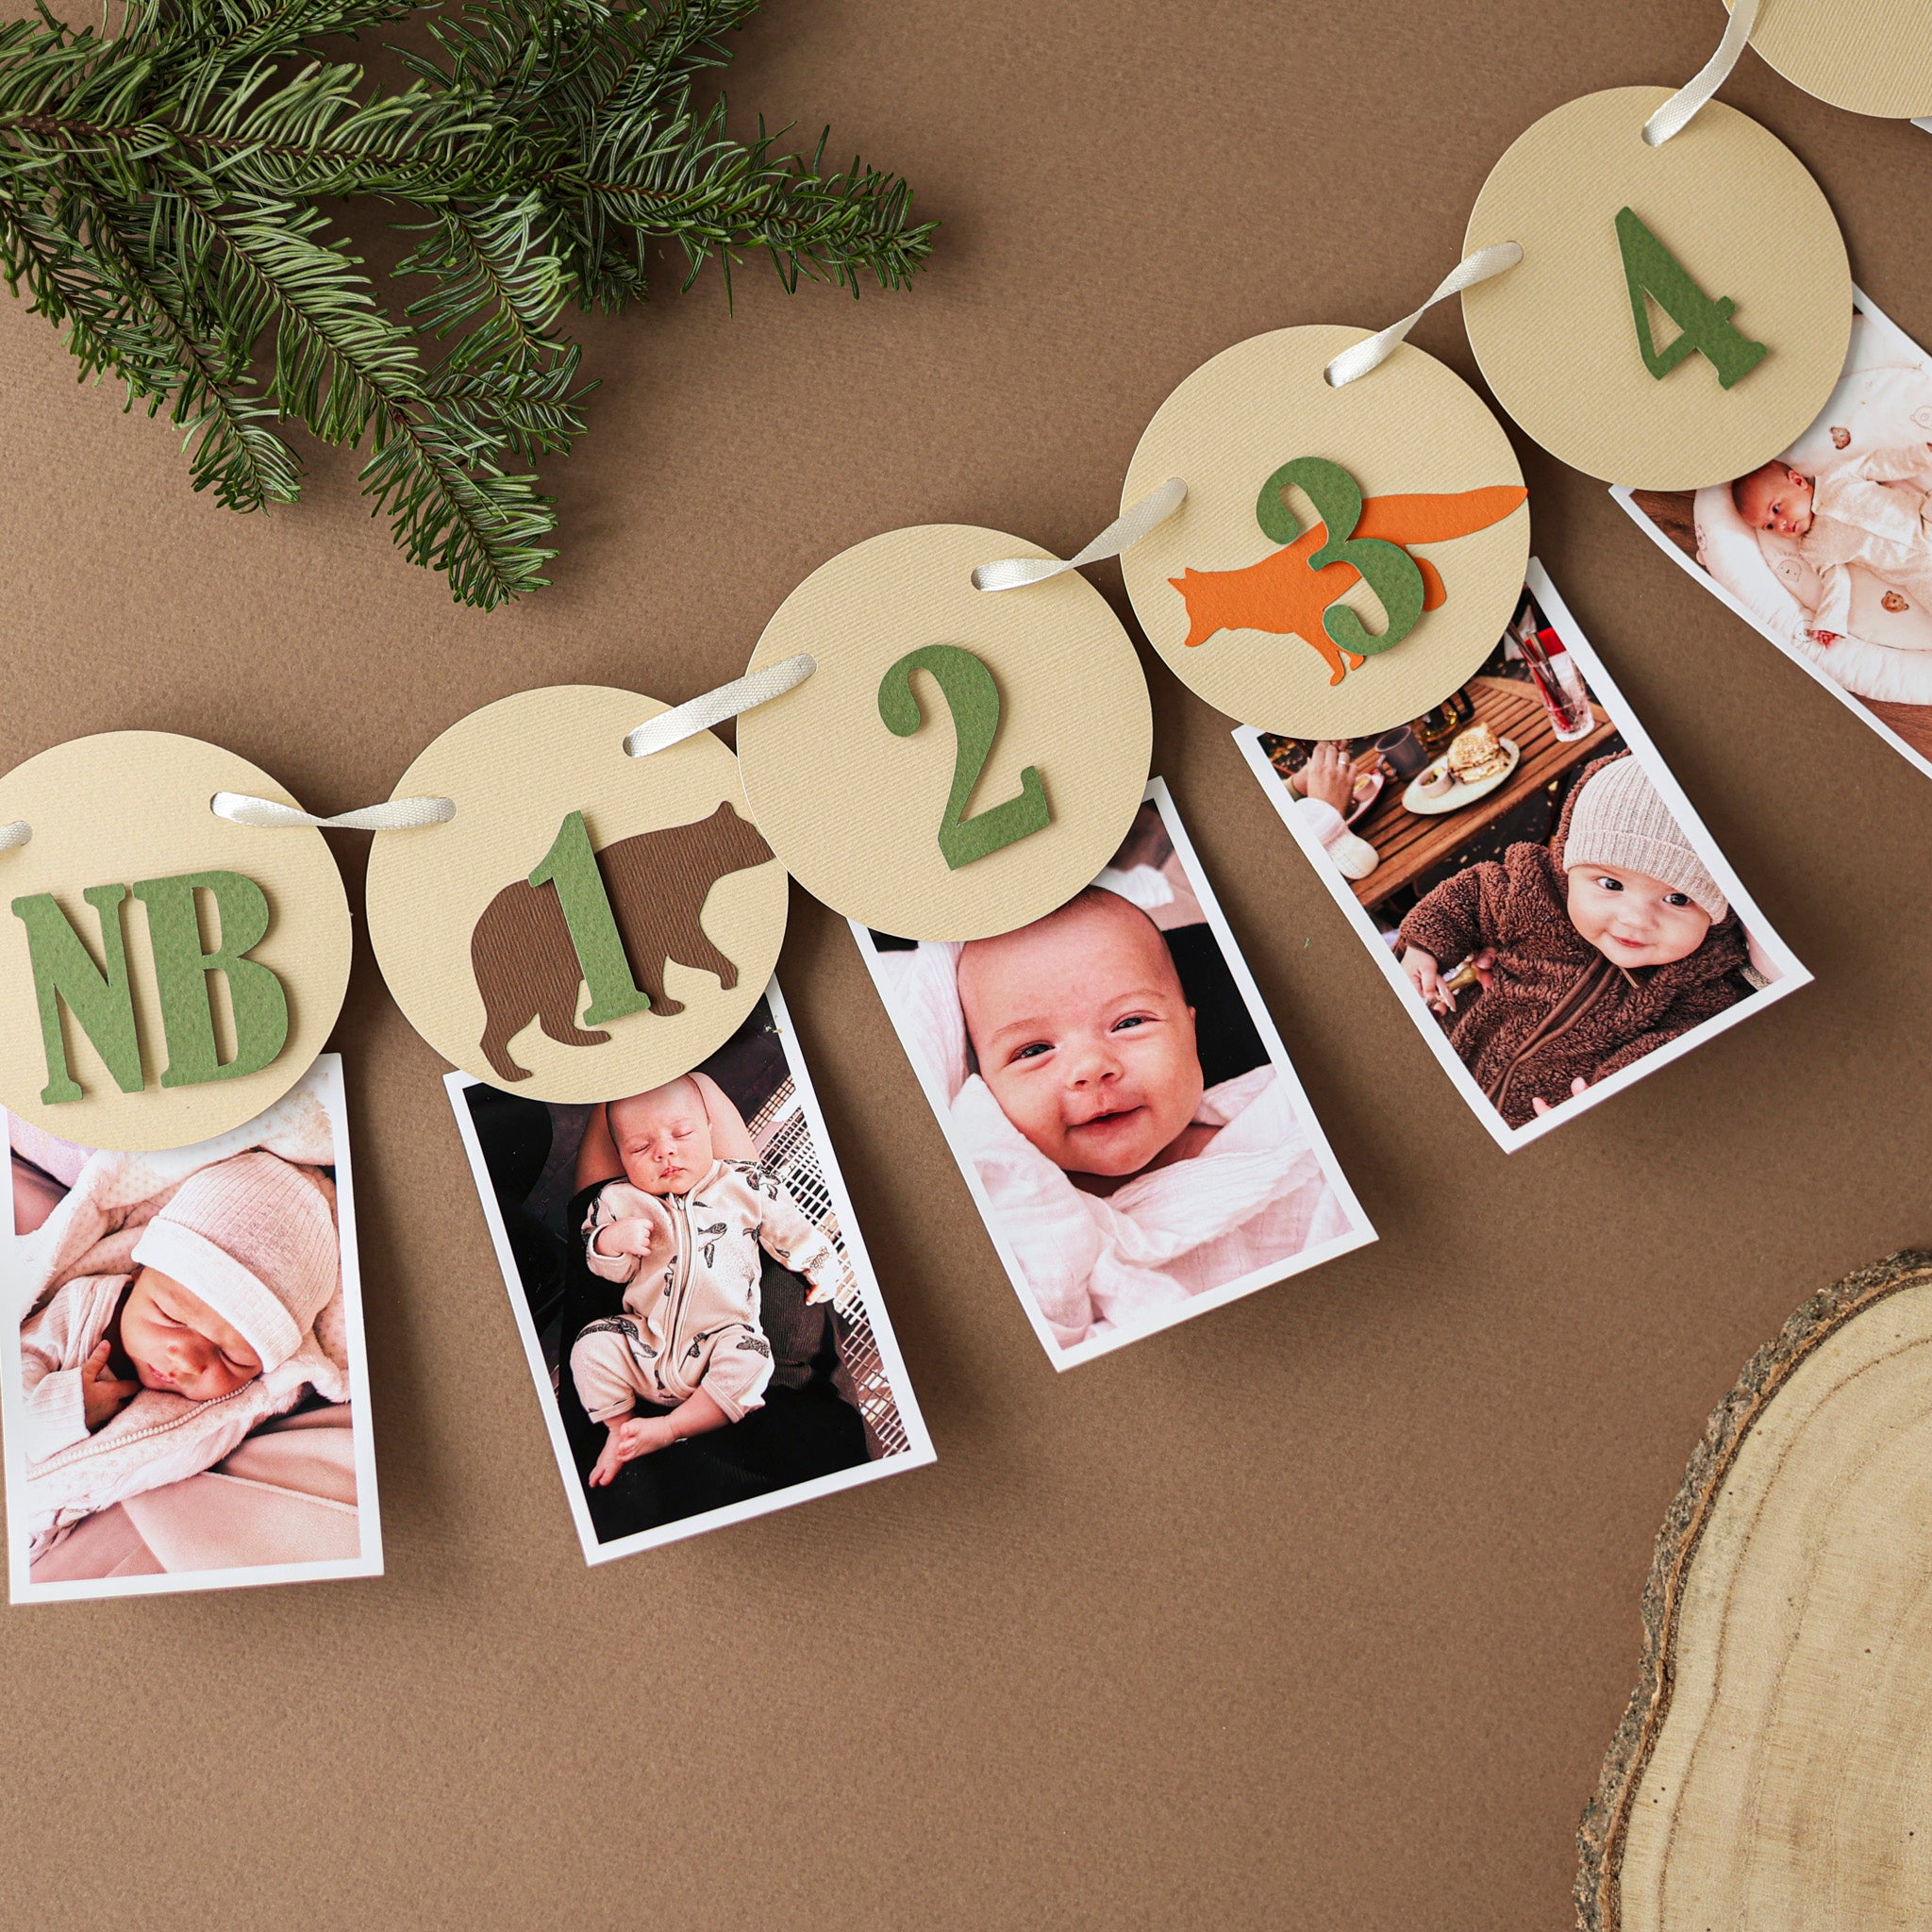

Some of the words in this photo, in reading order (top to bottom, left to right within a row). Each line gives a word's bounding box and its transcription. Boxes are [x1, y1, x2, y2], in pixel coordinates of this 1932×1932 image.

[1615, 207, 1768, 390] 4
[1257, 457, 1424, 656] 3
[878, 644, 1052, 870] 2
[11, 872, 290, 1105] NB
[528, 809, 651, 1026] 1
